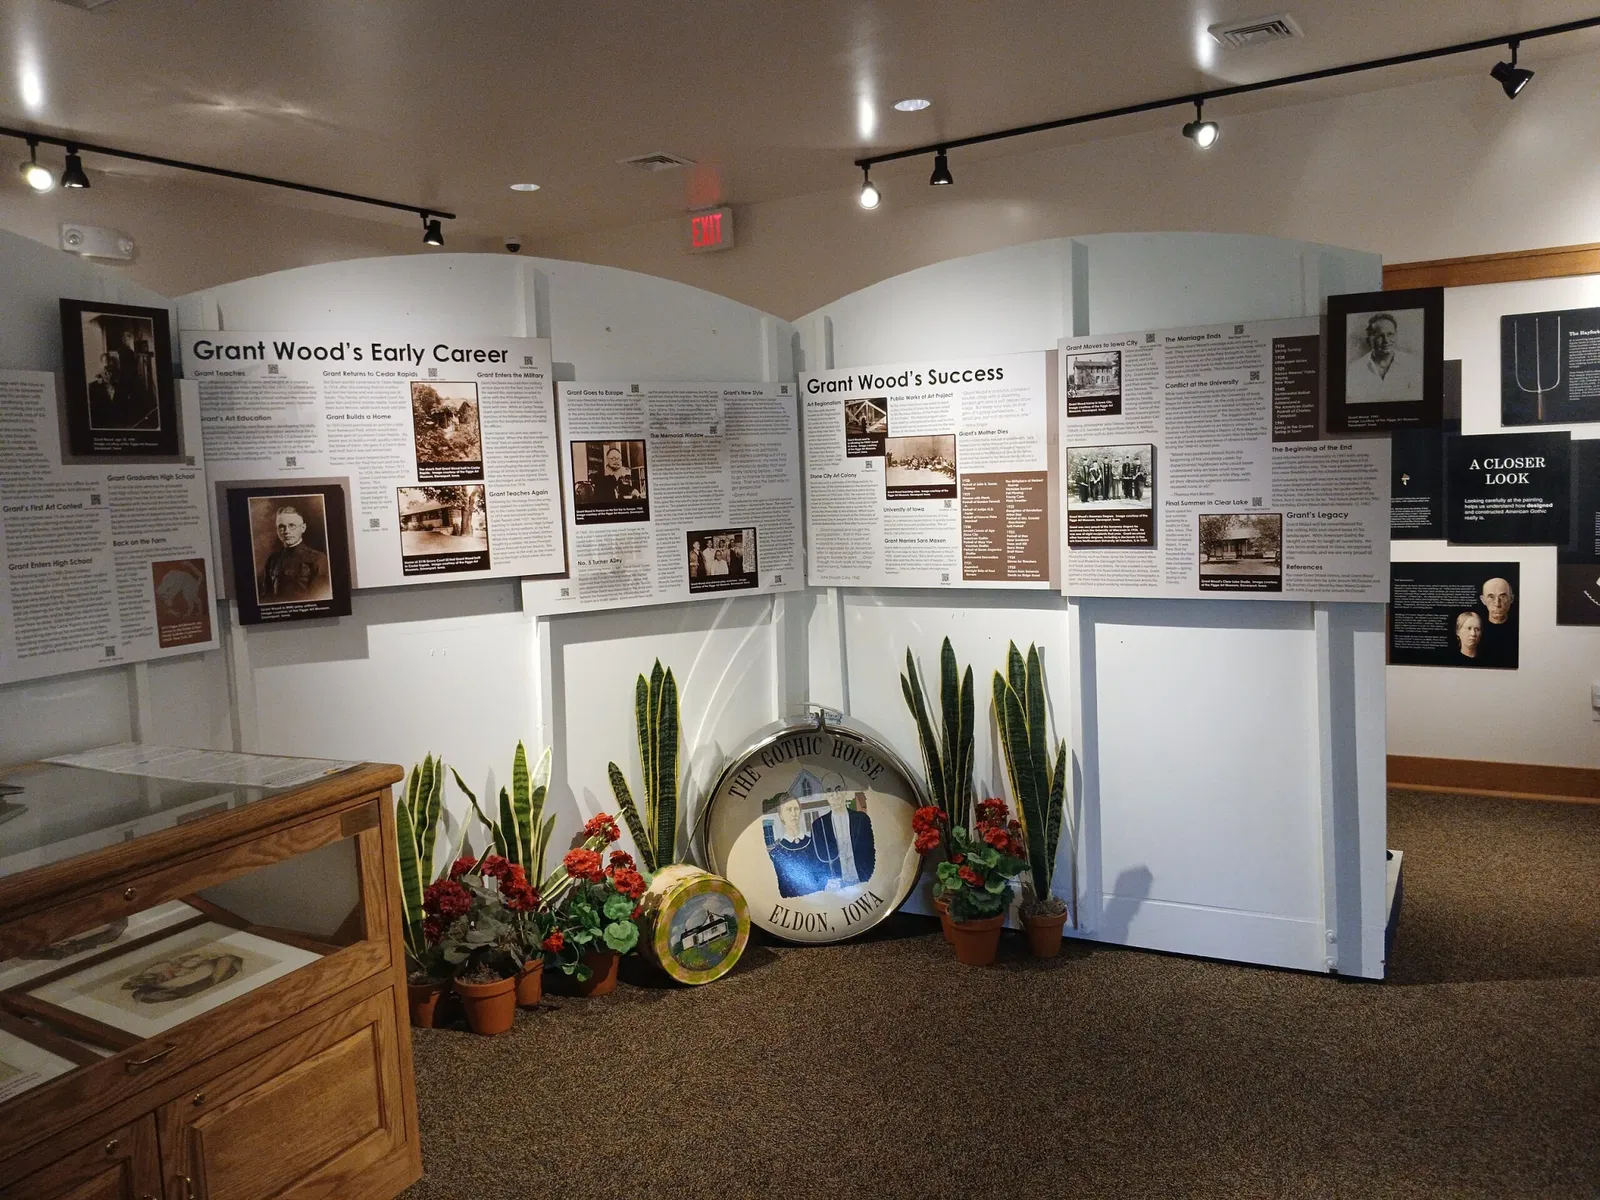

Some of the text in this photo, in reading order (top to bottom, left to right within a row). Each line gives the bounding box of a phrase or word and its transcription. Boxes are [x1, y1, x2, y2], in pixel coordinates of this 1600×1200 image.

[692, 213, 722, 247] EXIT
[193, 340, 508, 366] Grant Wood's Early Career
[807, 366, 1004, 394] Grant Wood's Success
[1469, 457, 1546, 470] A CLOSER
[160, 473, 173, 481] High
[1485, 473, 1529, 485] LOOK
[532, 489, 548, 497] Again
[3, 505, 28, 513] Grant's
[30, 504, 44, 512] First
[31, 561, 51, 569] Enters
[53, 560, 68, 569] High
[70, 558, 92, 566] School
[728, 737, 885, 800] THE GOTHIC HOUSE
[768, 890, 884, 933] ELDON, IOWA
